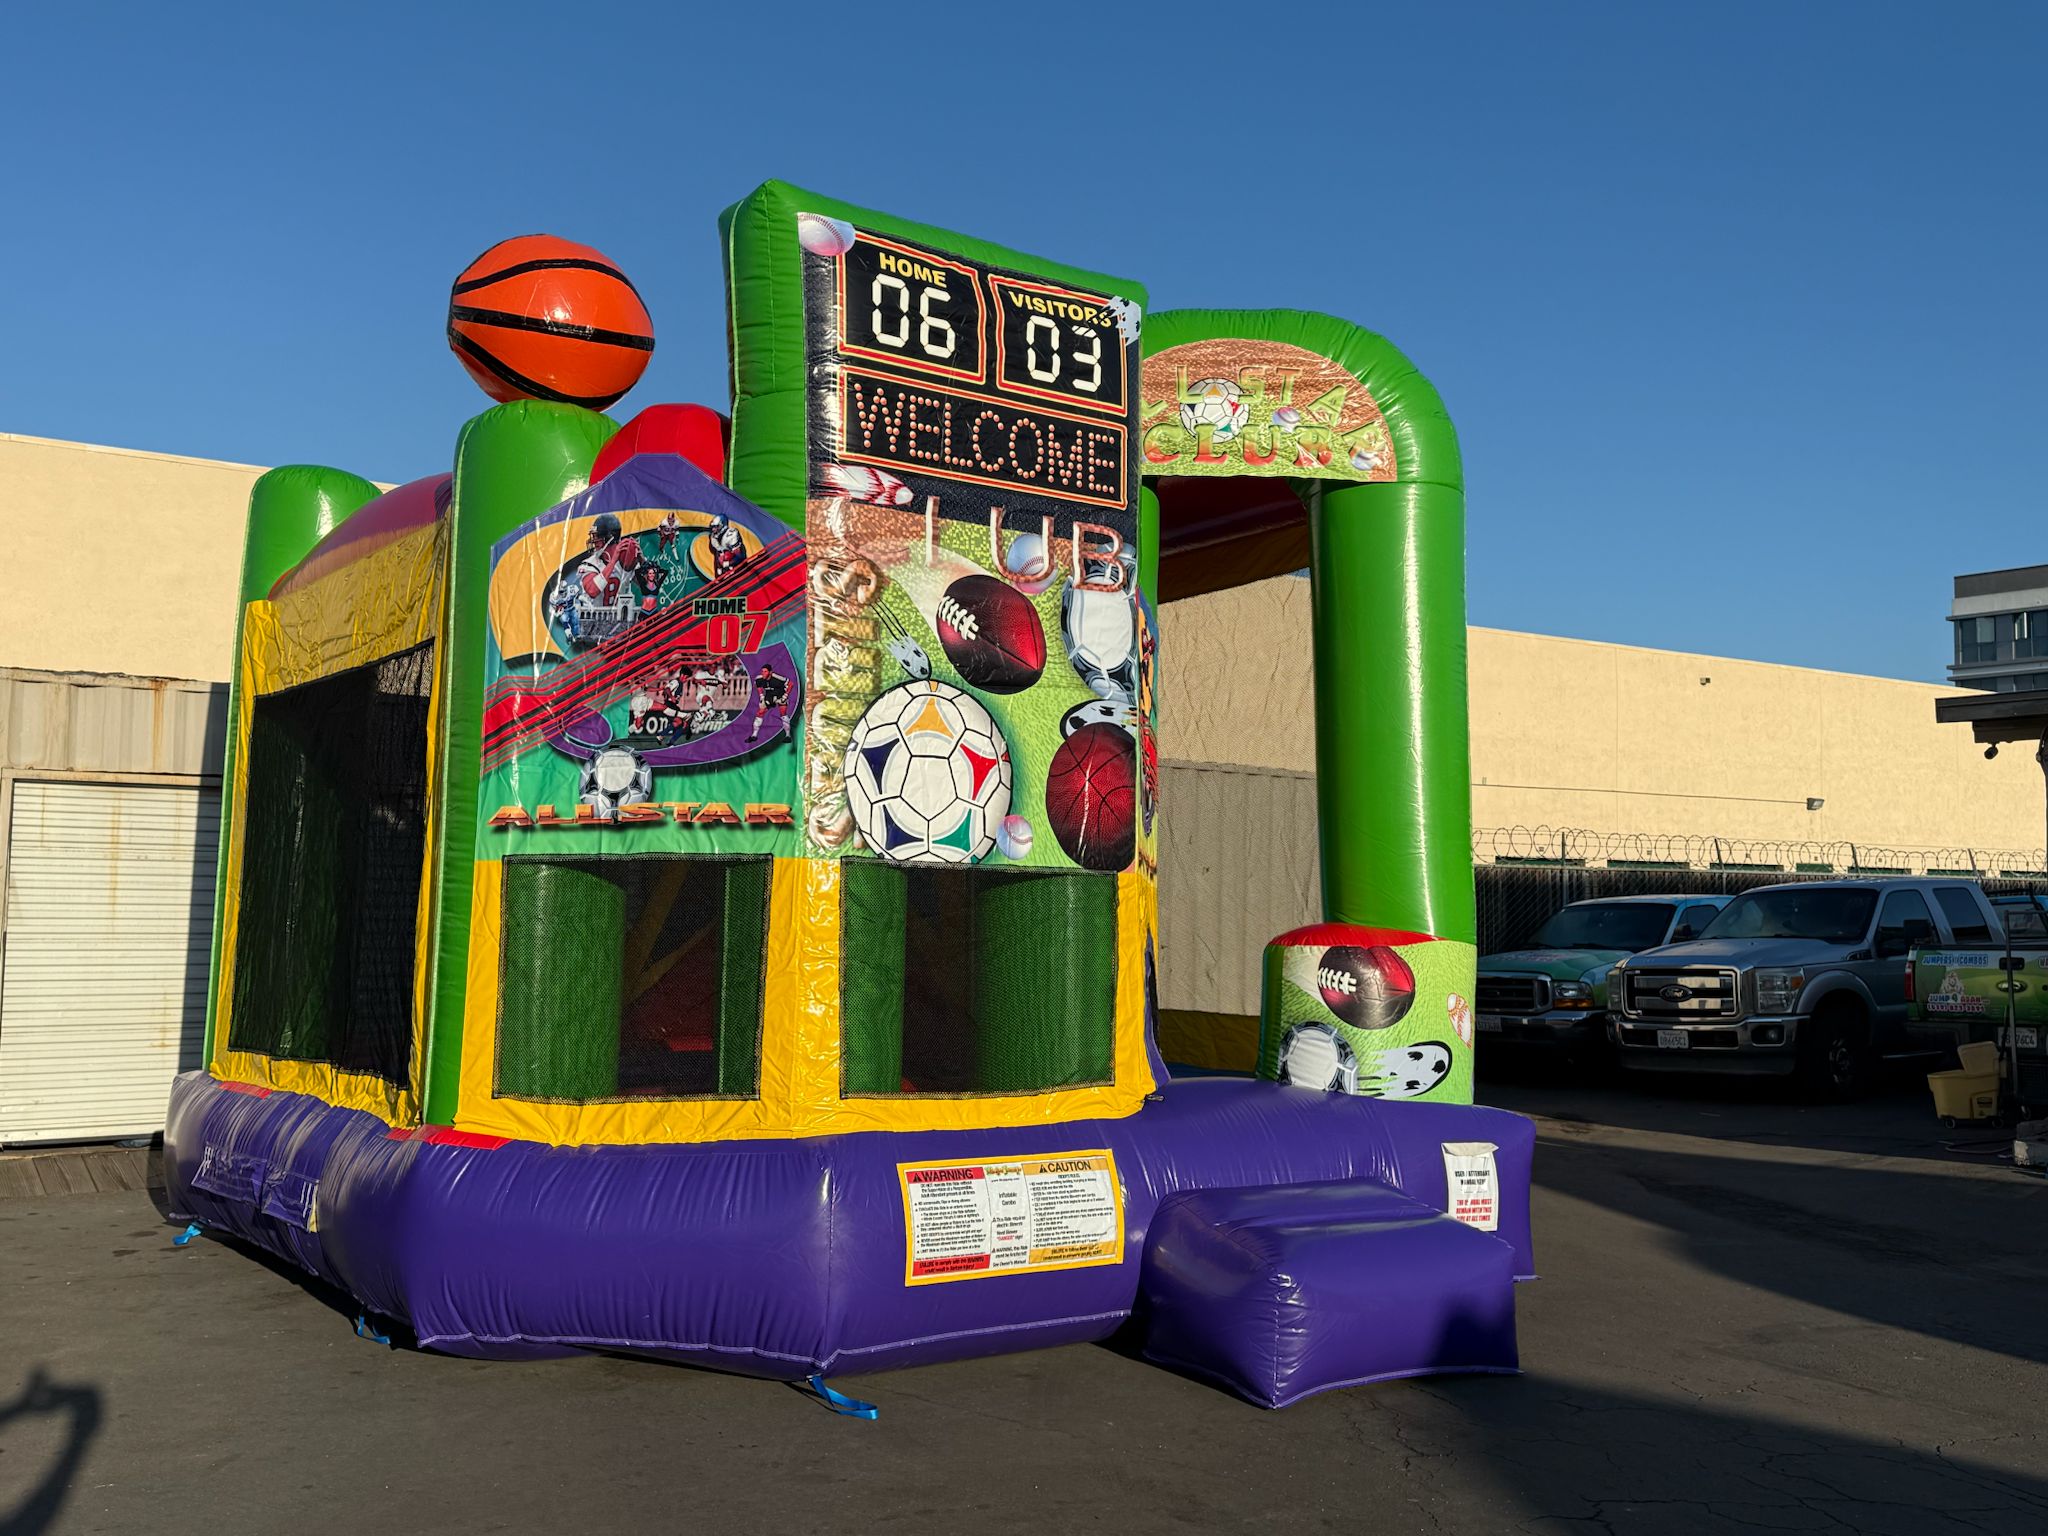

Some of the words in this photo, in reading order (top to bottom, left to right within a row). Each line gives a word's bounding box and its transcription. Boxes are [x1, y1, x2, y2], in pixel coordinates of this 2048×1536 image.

[878, 251, 948, 288] HOME
[871, 273, 956, 359] 06
[1008, 290, 1112, 328] VISITORS
[1025, 315, 1102, 392] 03
[853, 382, 1116, 494] WELCOME
[1143, 422, 1334, 469] CLUB
[693, 598, 747, 616] HOME
[705, 612, 771, 655] 07
[923, 1169, 974, 1182] WARNING
[1047, 1160, 1092, 1173] CAUTION
